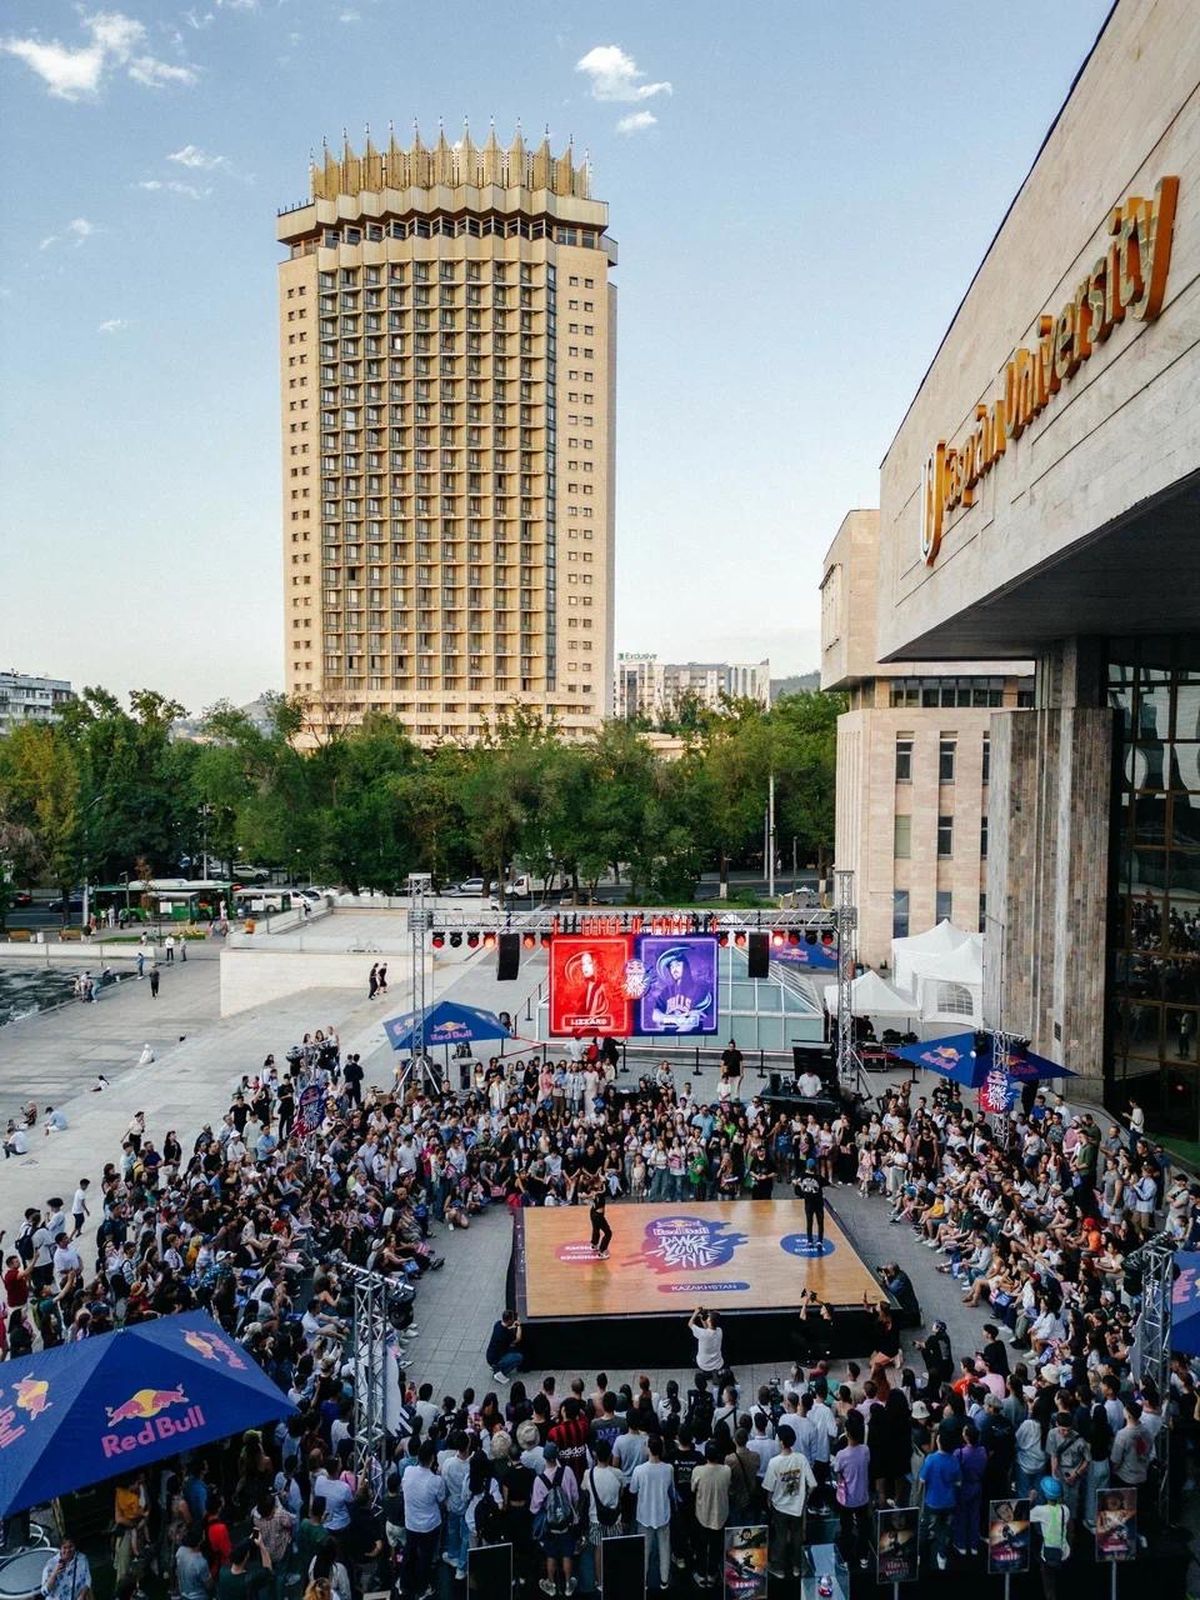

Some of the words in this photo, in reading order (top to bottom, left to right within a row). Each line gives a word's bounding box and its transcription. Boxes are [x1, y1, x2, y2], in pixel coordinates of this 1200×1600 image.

[1005, 175, 1181, 440] University
[658, 1235, 709, 1248] DANCE
[665, 1242, 721, 1258] YOUR
[664, 1251, 719, 1268] STYLE
[671, 1283, 738, 1292] KAZAKHSTAN
[101, 1422, 153, 1458] Red
[155, 1405, 206, 1439] Bull
[559, 1446, 585, 1456] adidas
